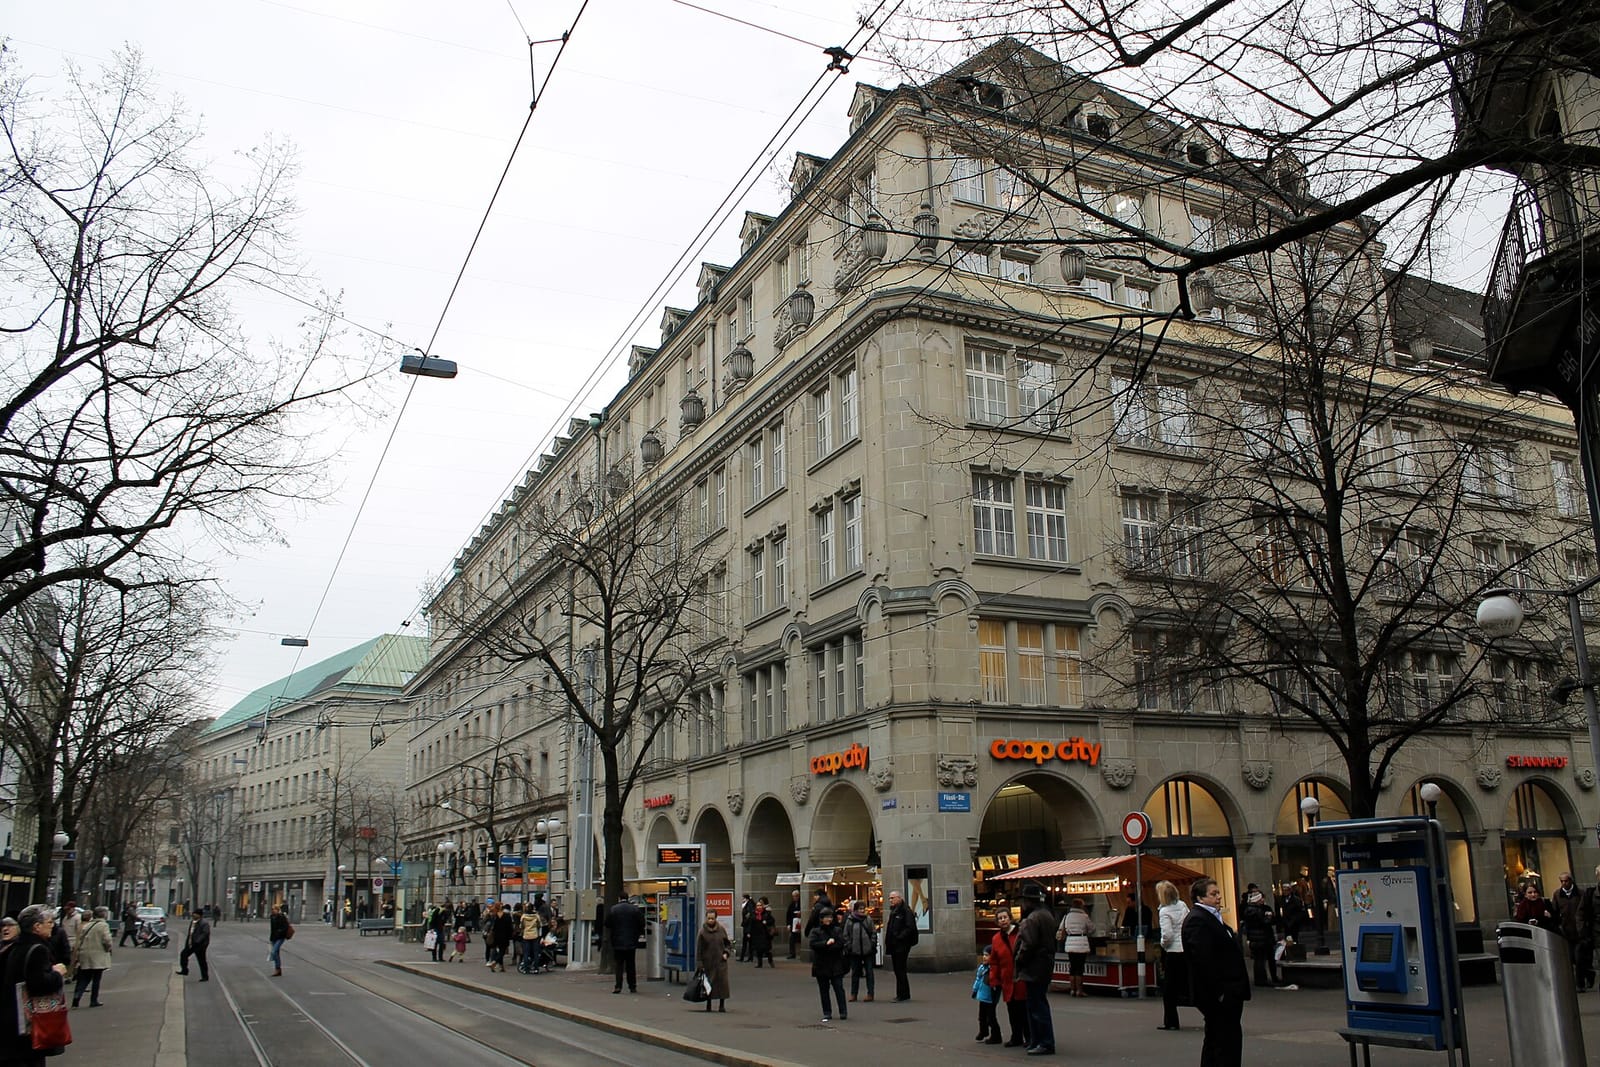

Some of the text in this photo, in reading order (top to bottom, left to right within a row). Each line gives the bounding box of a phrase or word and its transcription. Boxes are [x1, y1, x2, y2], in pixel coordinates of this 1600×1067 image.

[810, 742, 869, 776] coop city
[990, 736, 1102, 766] coop city
